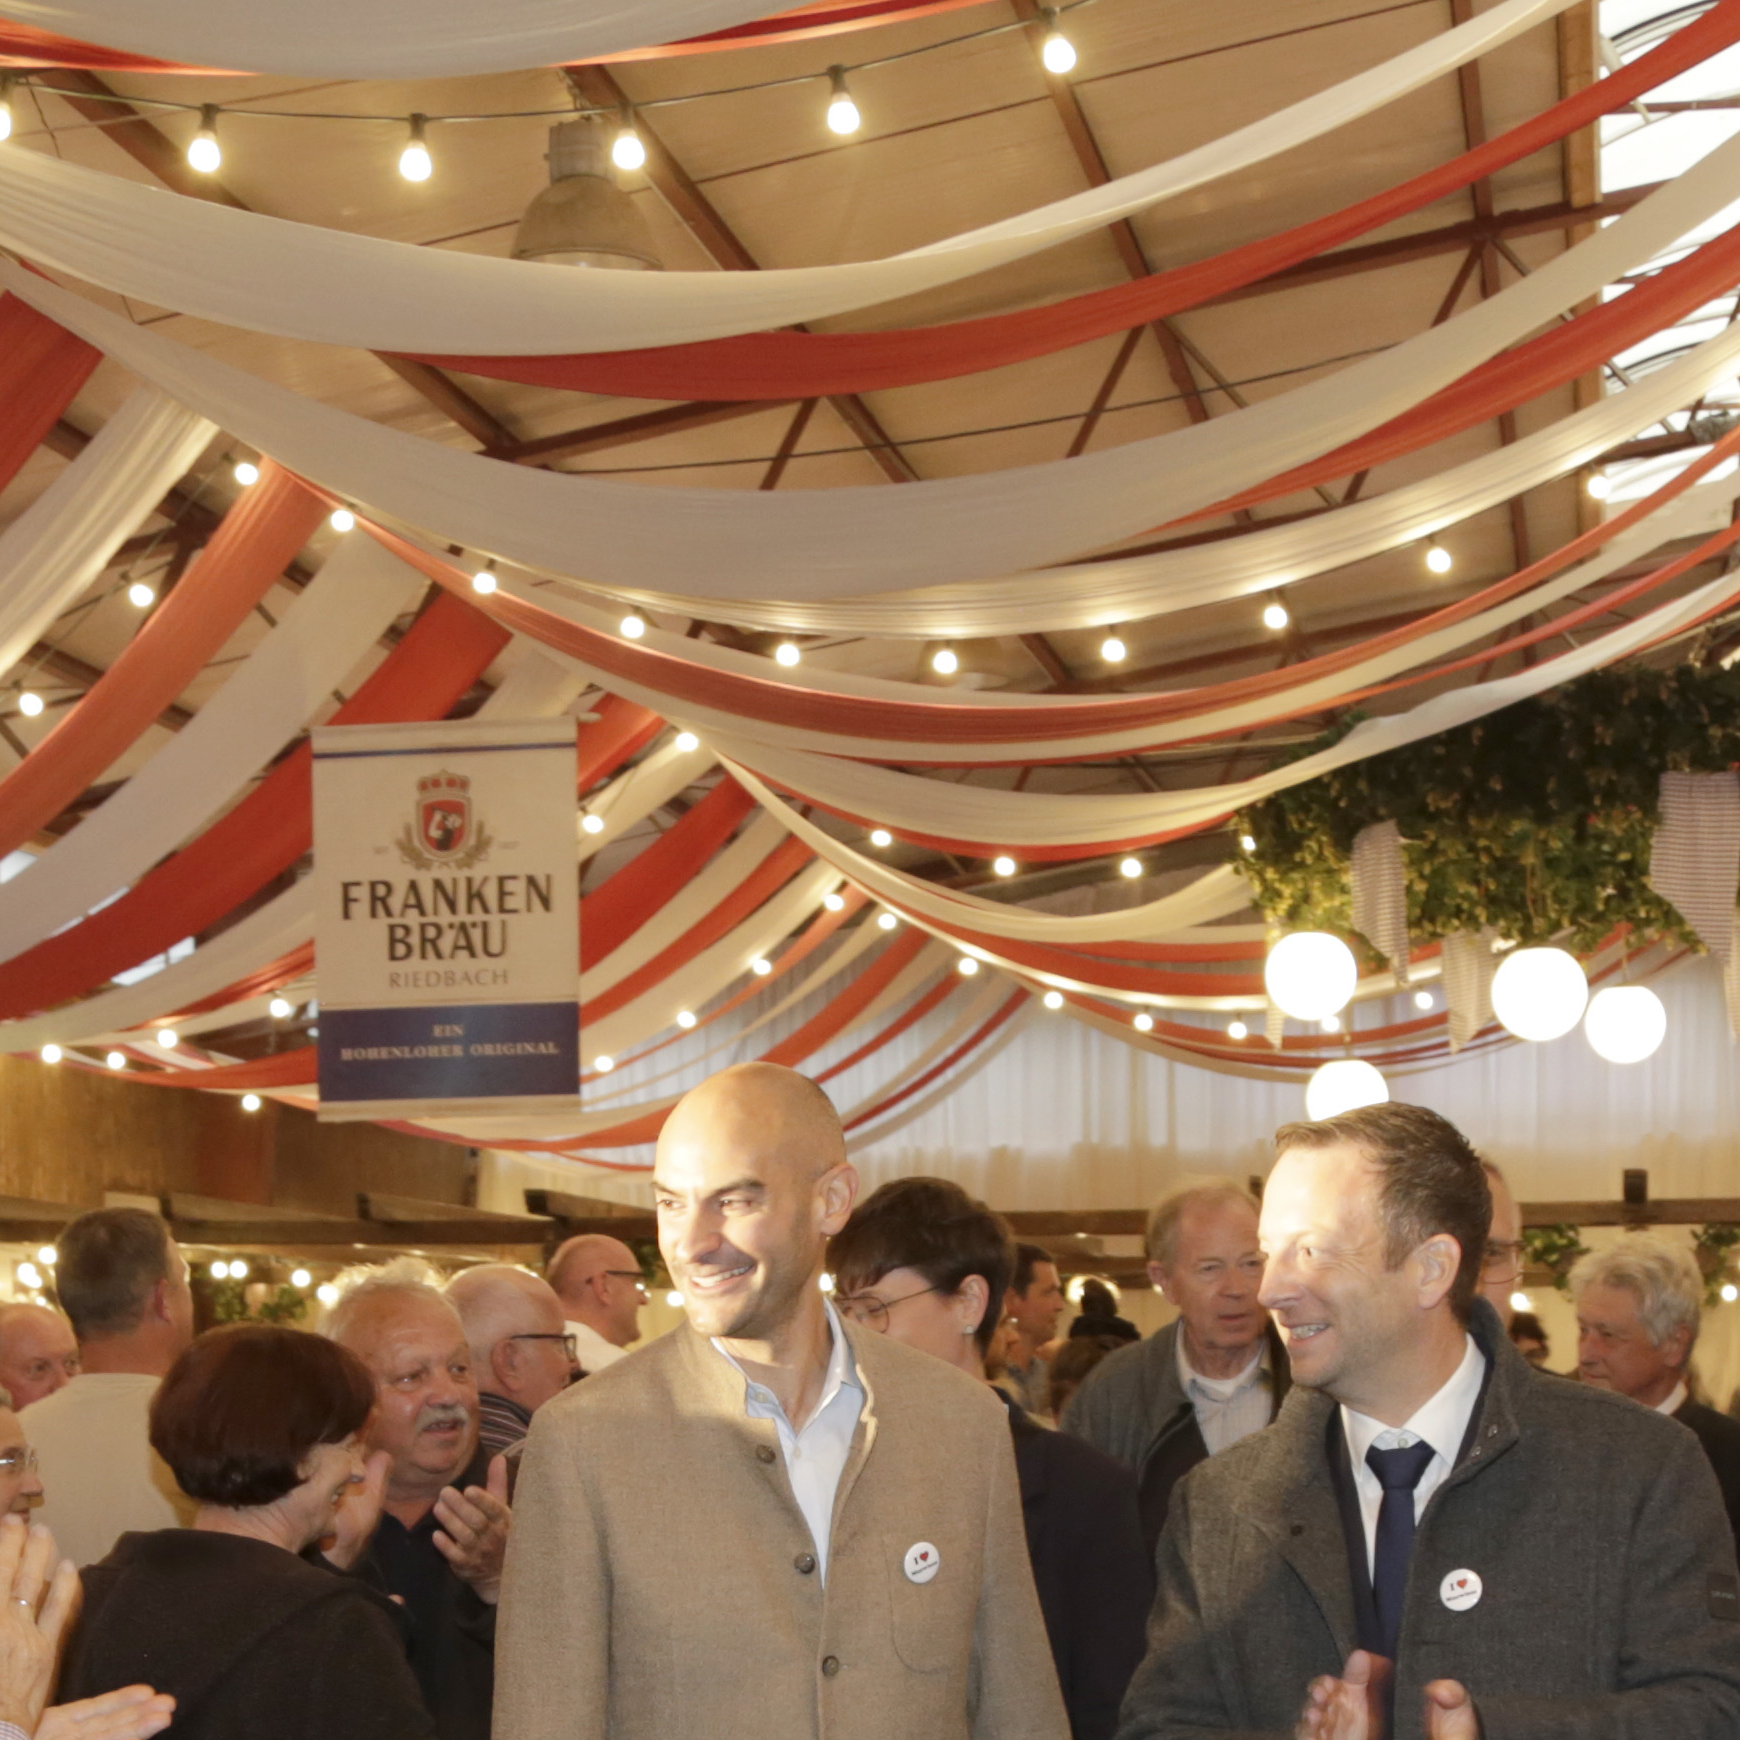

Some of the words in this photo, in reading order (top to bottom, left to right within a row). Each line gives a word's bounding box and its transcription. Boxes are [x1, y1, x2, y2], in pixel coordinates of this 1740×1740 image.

[340, 874, 553, 921] FRANKEN
[387, 919, 508, 963] BRÄU
[388, 968, 509, 989] RIEDBACH
[432, 1023, 465, 1038] EIN
[469, 1041, 560, 1057] ORIGINAL
